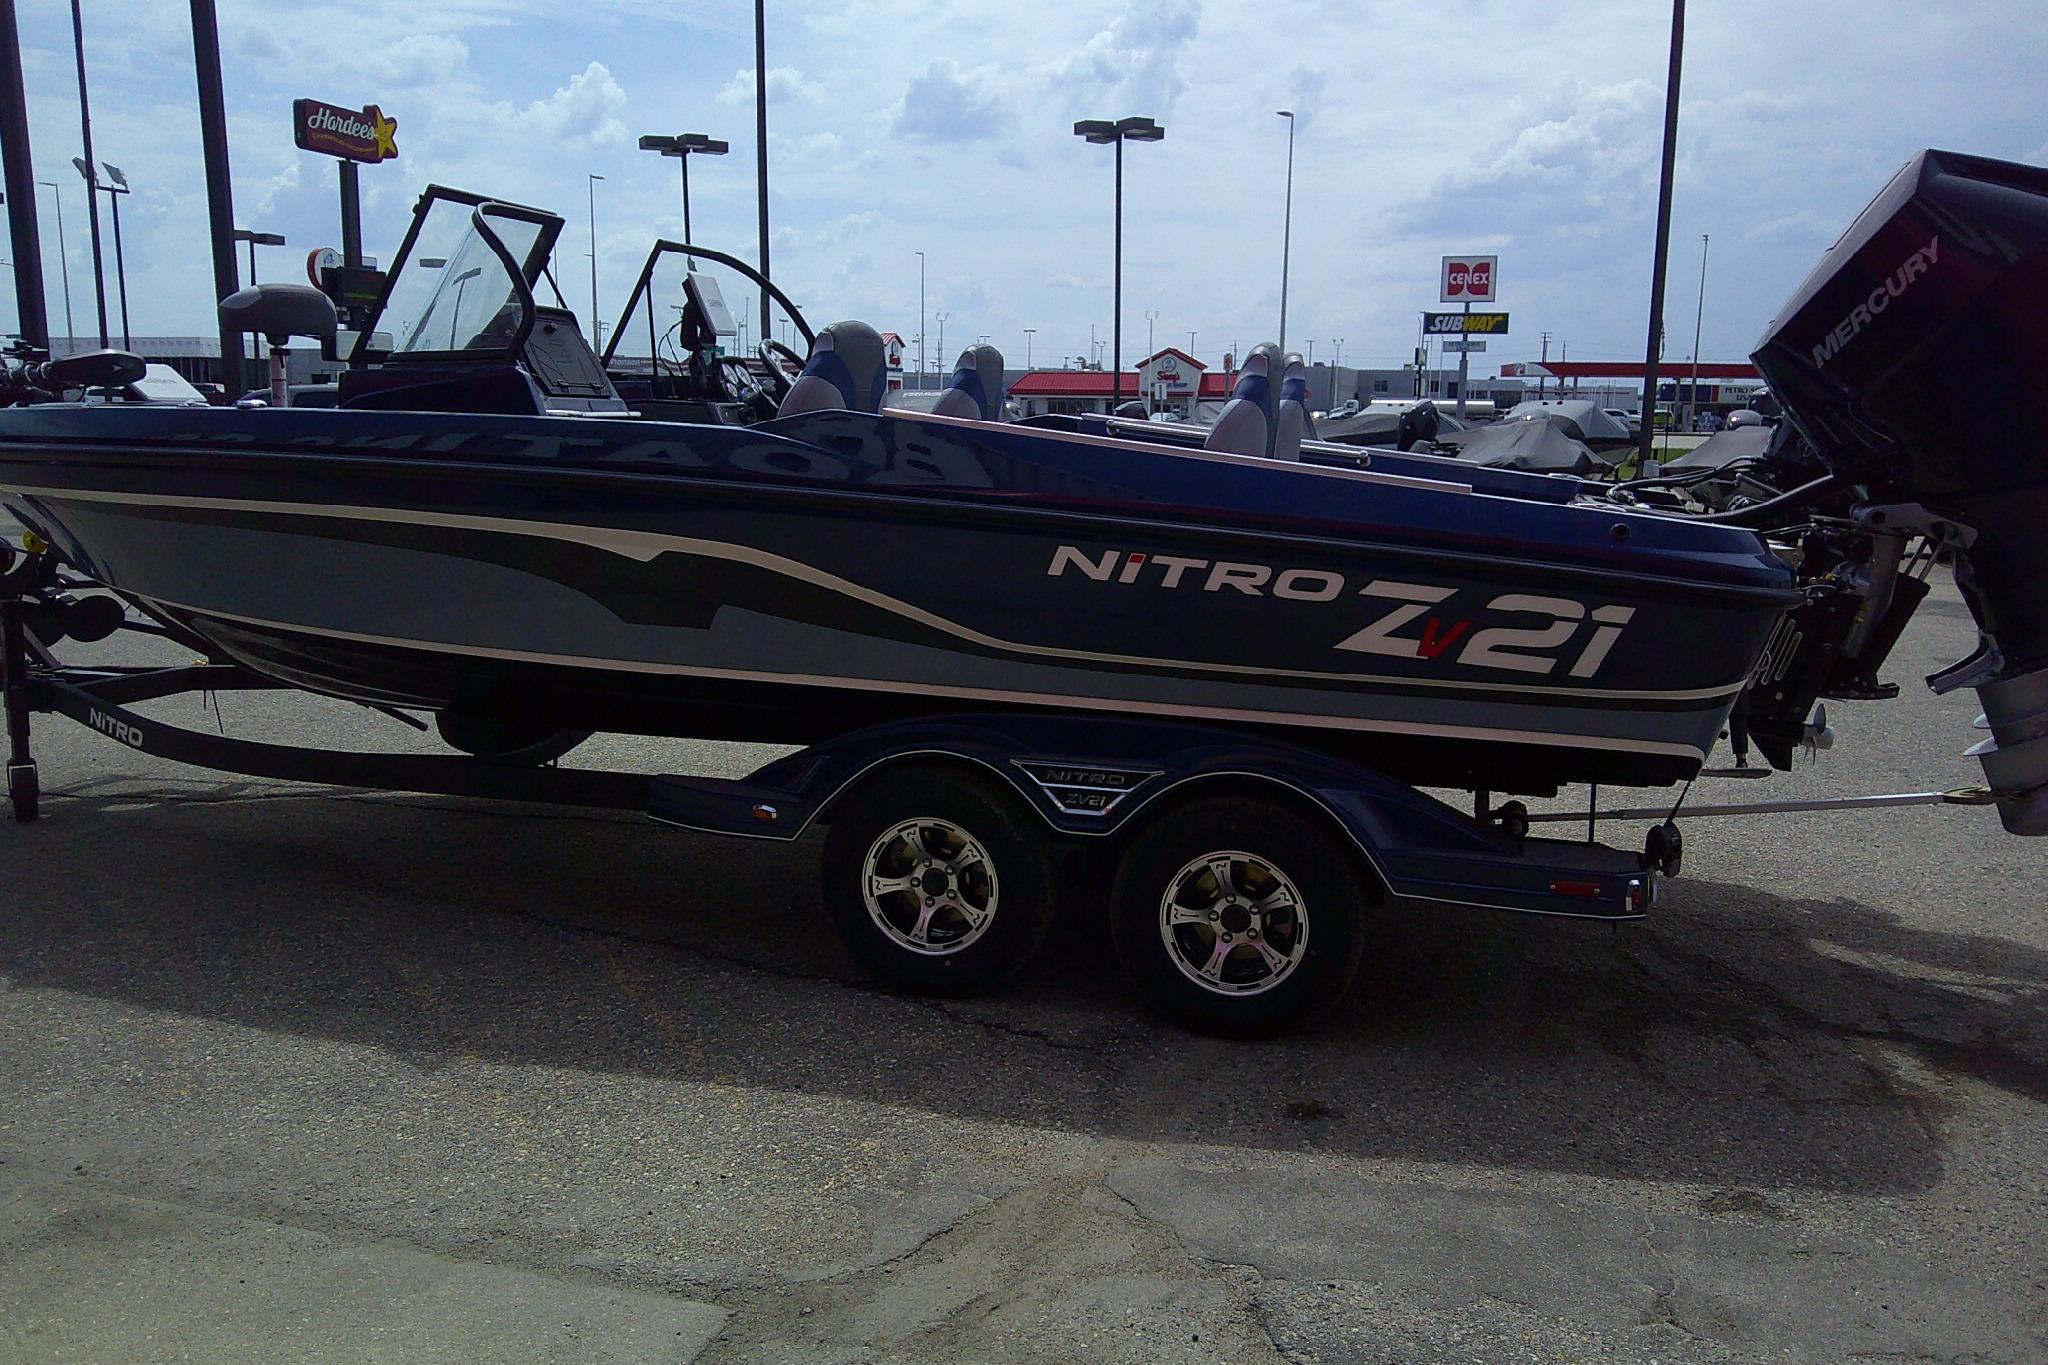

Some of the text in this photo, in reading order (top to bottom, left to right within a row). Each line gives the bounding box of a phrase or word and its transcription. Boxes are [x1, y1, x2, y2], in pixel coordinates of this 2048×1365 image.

[308, 108, 376, 140] Hardee's
[1450, 272, 1489, 286] CENEX
[1811, 234, 1939, 369] MERCURY
[1429, 315, 1503, 332] SUBWAY
